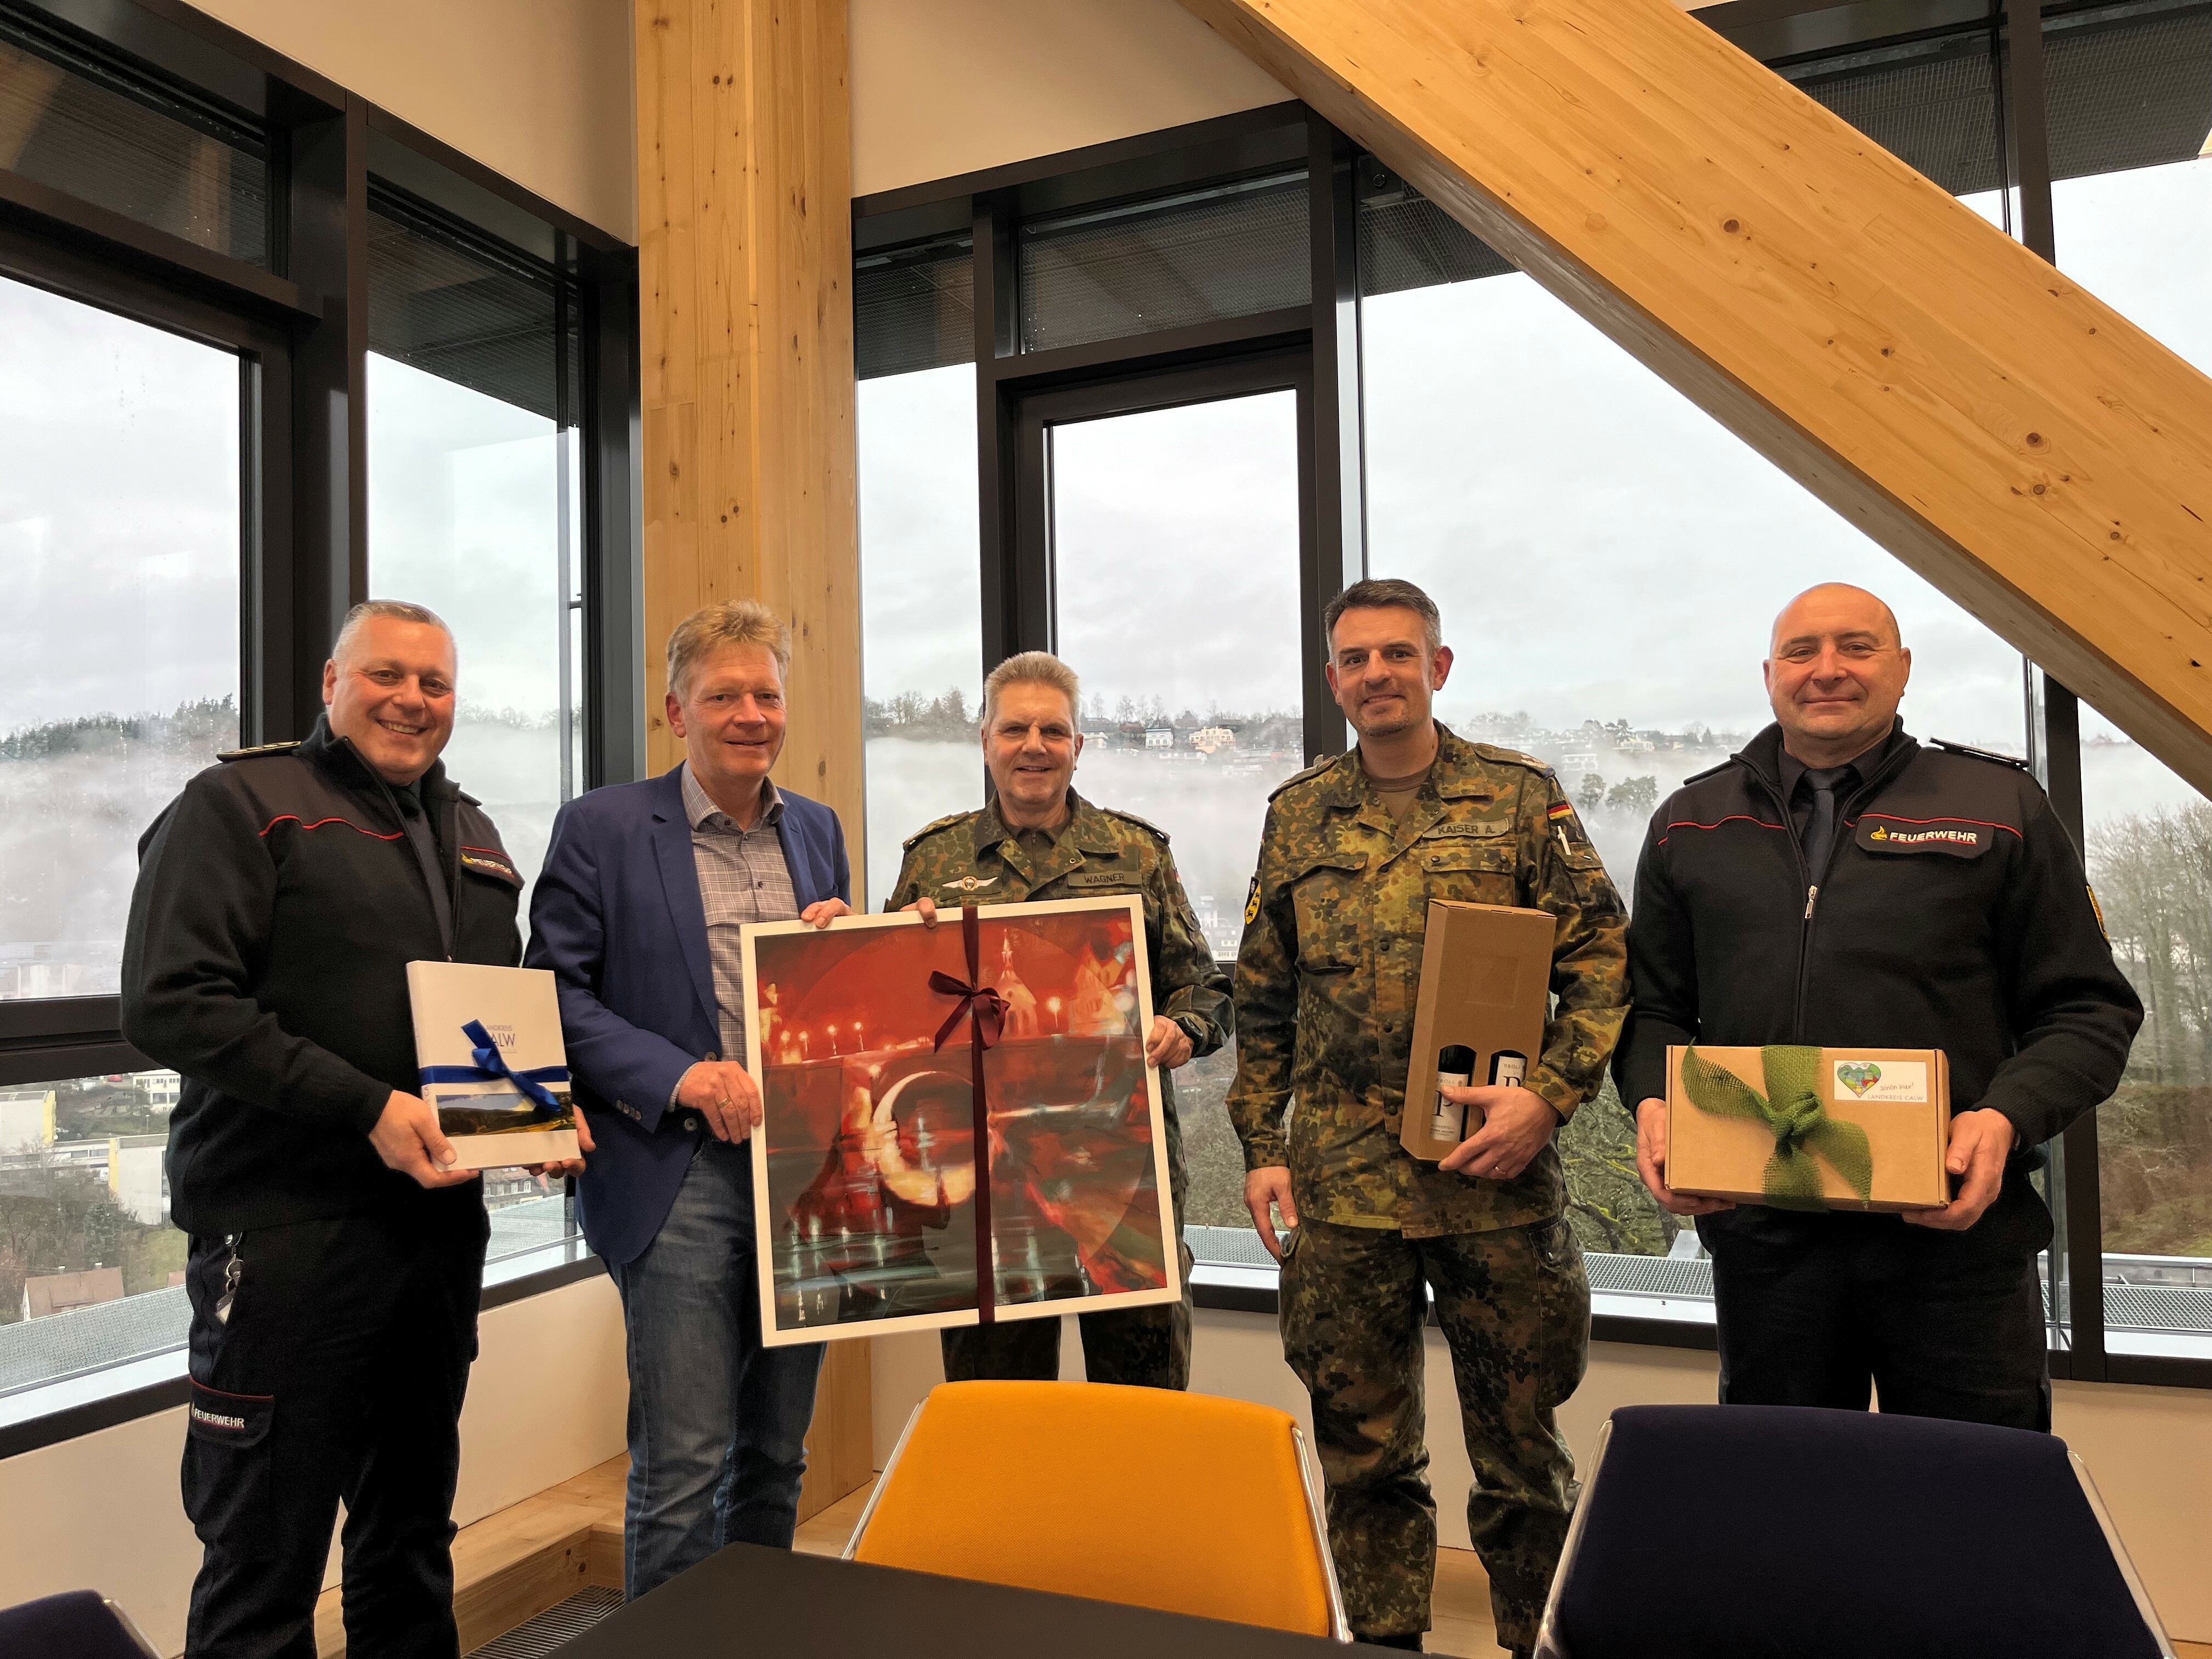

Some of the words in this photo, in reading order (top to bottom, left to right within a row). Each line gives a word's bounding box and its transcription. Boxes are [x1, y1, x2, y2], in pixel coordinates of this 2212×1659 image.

[1437, 824, 1479, 834] KAISER
[1889, 830, 1977, 843] FEUERWEHR
[1084, 872, 1125, 884] WAGNER
[492, 1032, 516, 1047] ALW
[194, 1408, 245, 1429] FEUERWEHR
